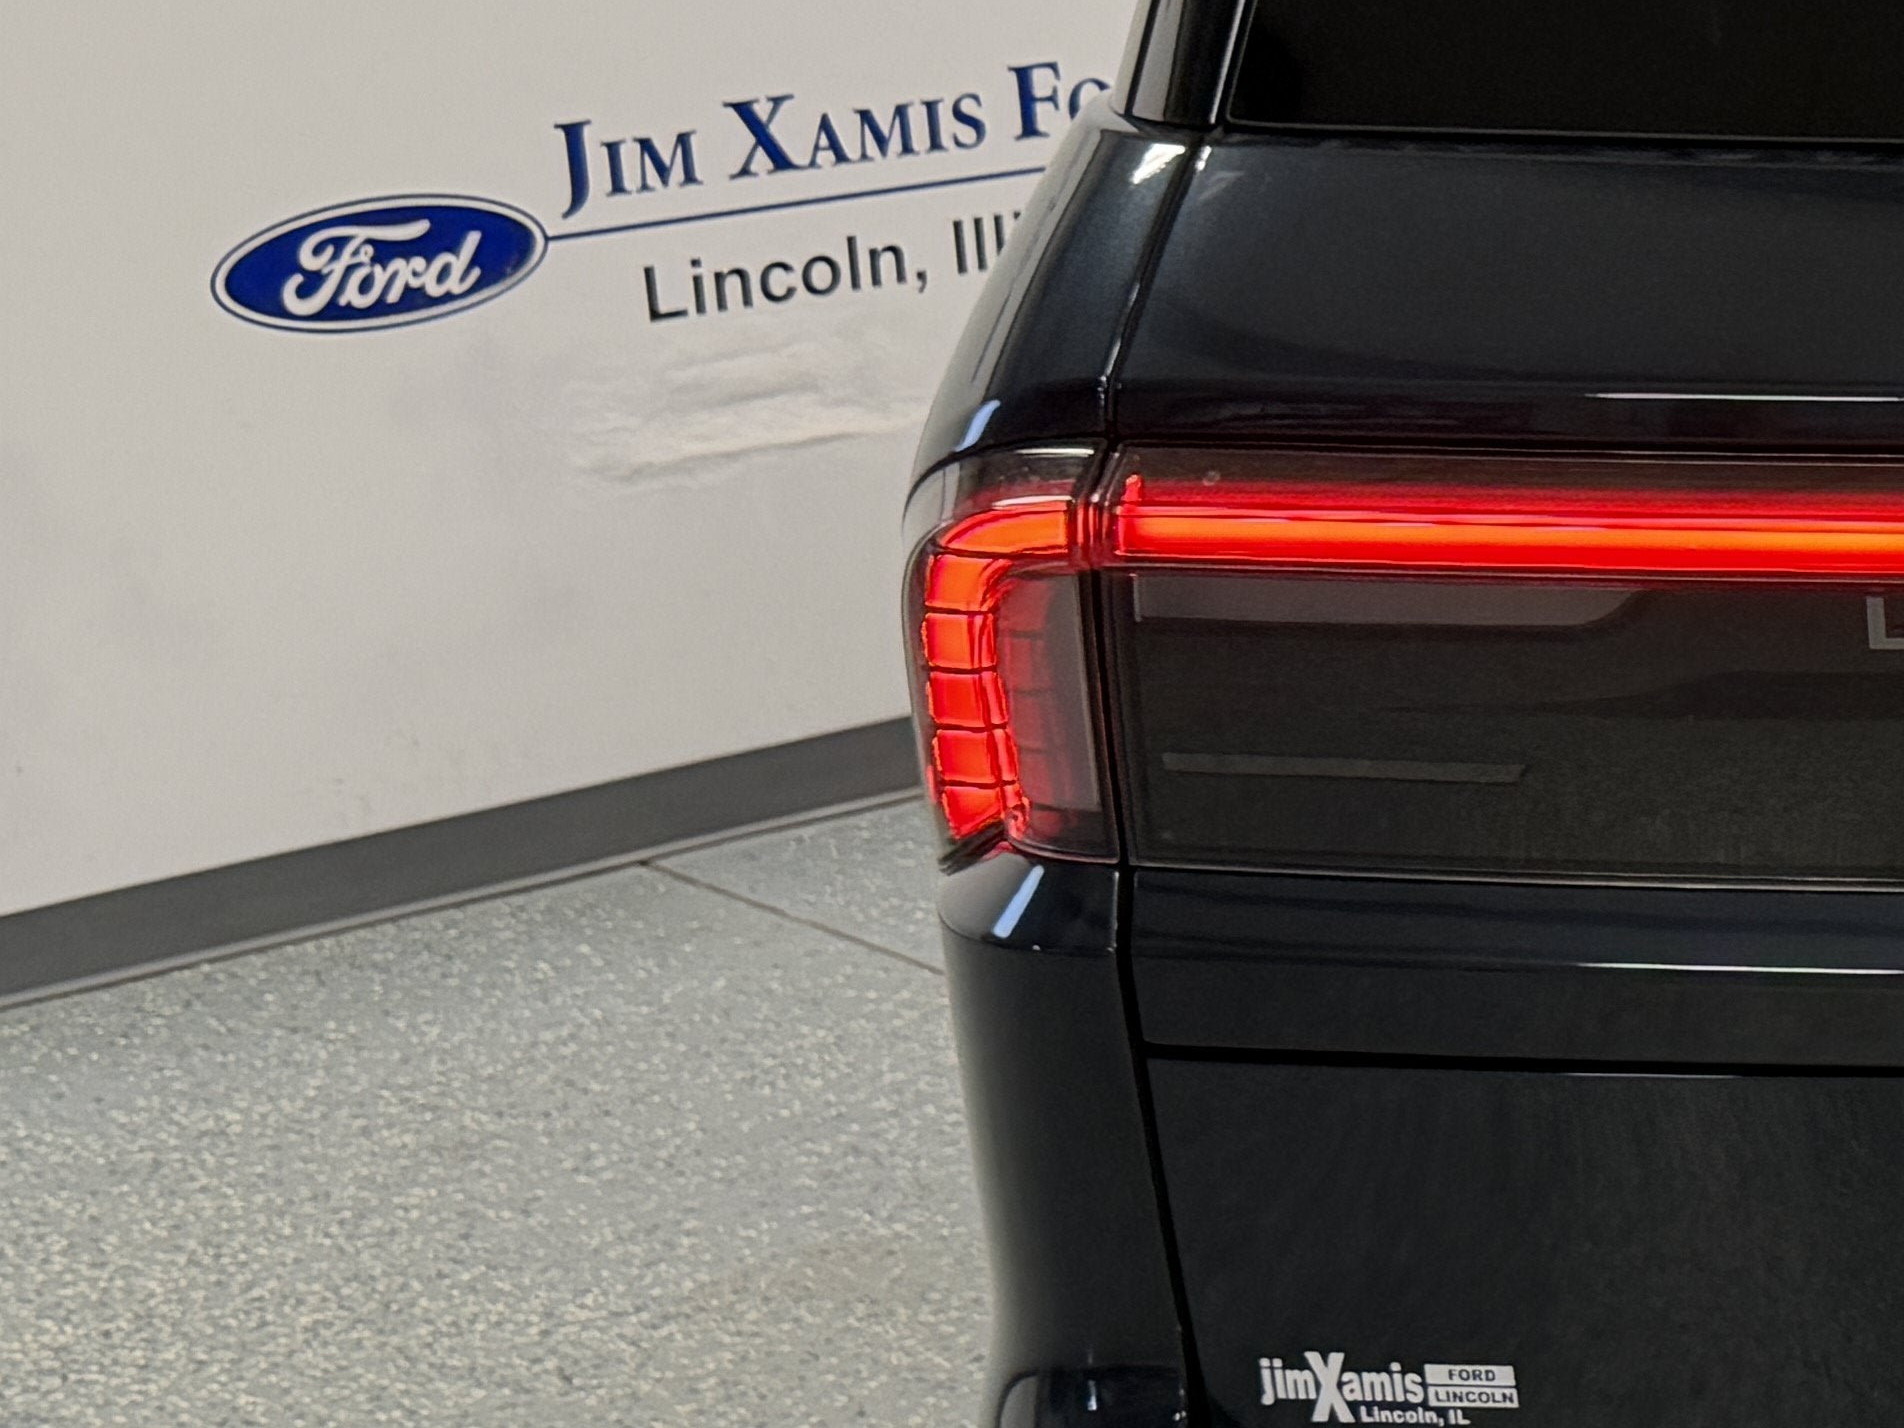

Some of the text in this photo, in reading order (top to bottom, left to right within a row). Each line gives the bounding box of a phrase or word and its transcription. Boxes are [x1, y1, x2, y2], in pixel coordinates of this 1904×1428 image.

[554, 119, 702, 220] JIM
[722, 93, 987, 177] XAMIS
[643, 236, 928, 324] Lincoln,
[1447, 1368, 1496, 1382] FORD
[1434, 1388, 1515, 1405] LINCOLN
[1359, 1405, 1471, 1428] Lincoln, IL
